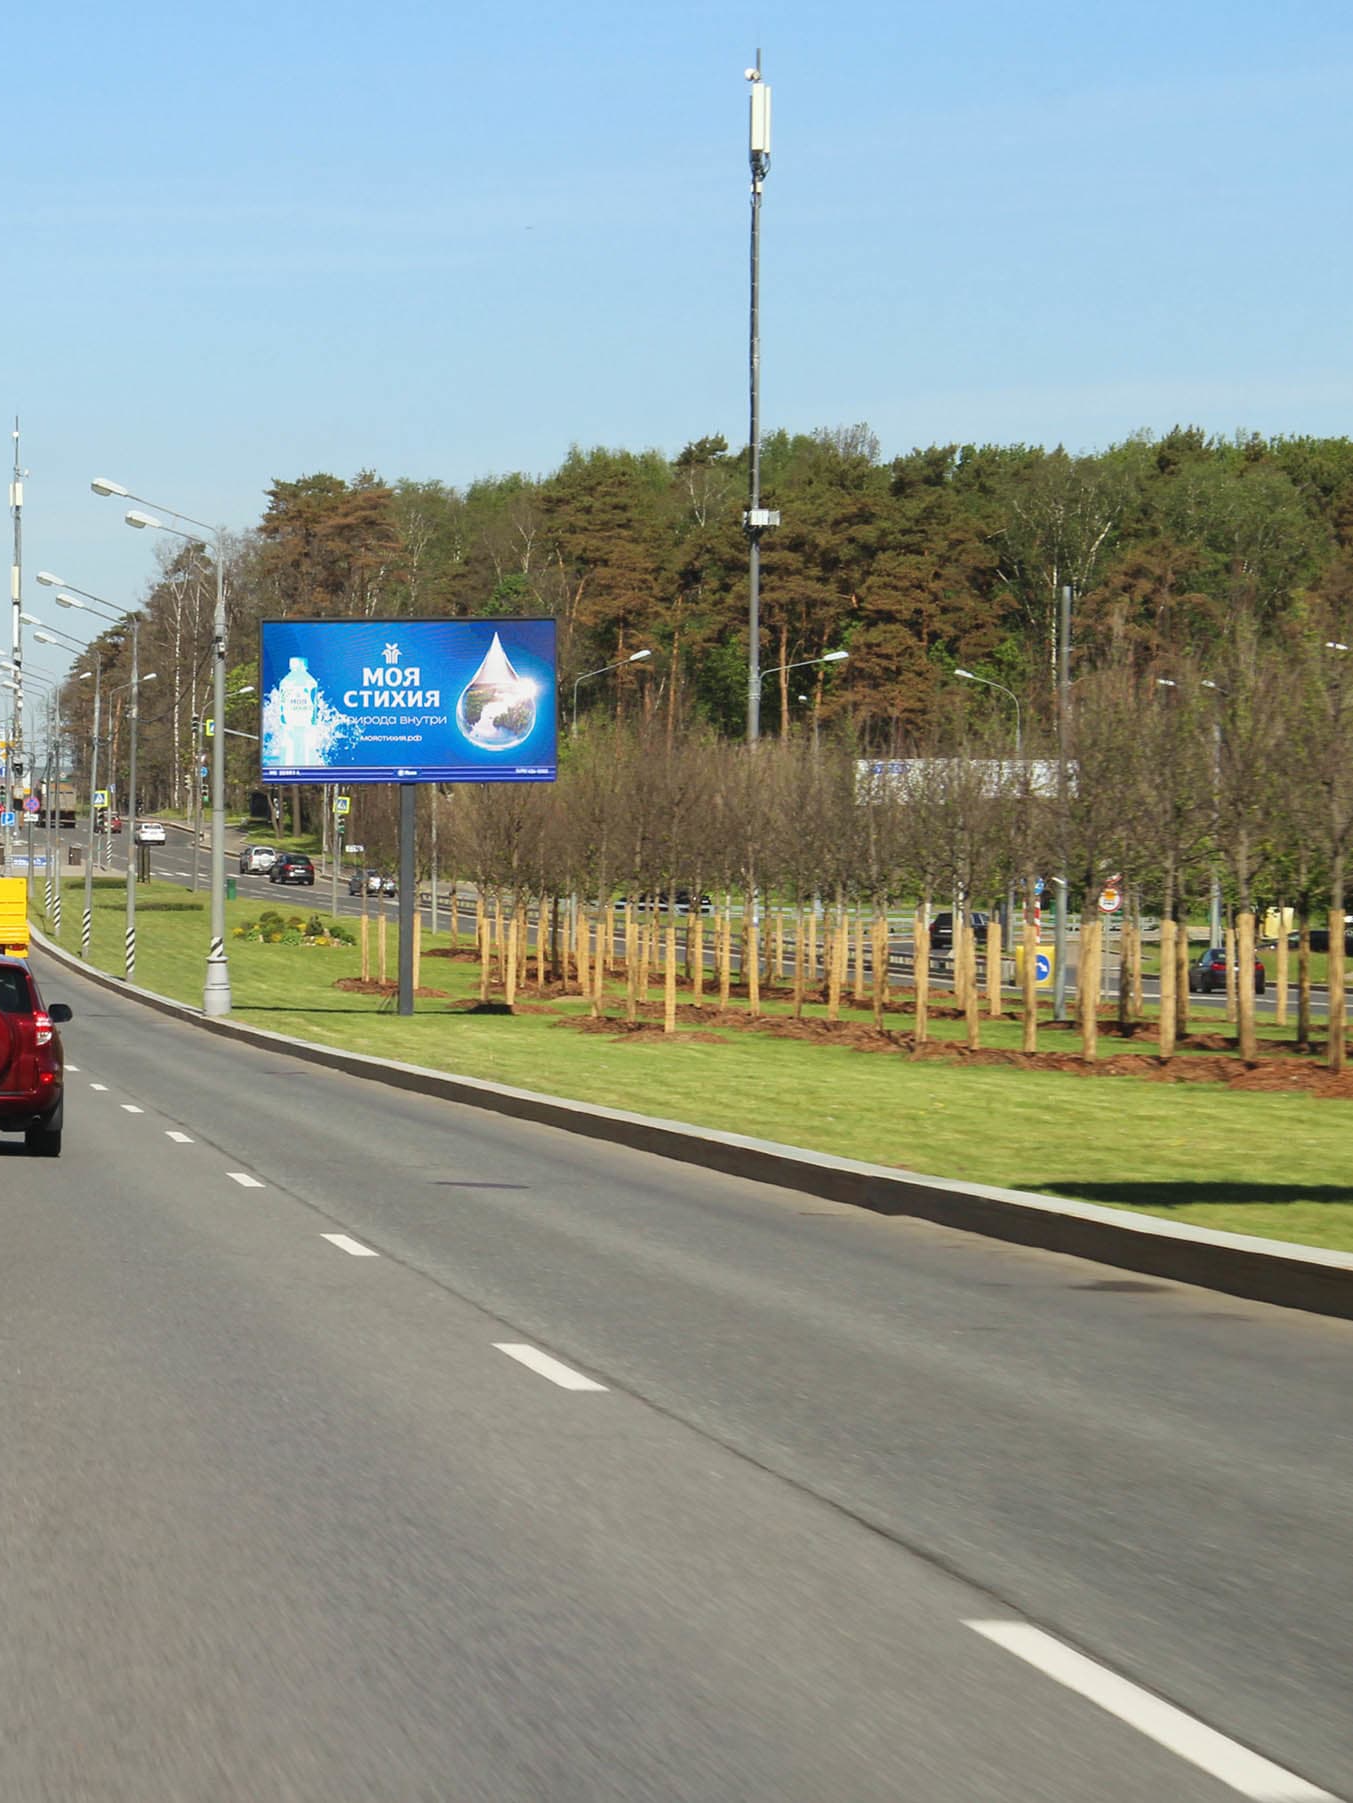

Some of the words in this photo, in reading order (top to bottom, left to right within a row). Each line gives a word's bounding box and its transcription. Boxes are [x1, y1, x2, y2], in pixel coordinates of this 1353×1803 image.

[362, 667, 421, 687] МОЯ
[343, 690, 441, 708] СТИХИЯ
[400, 715, 448, 726] внутри
